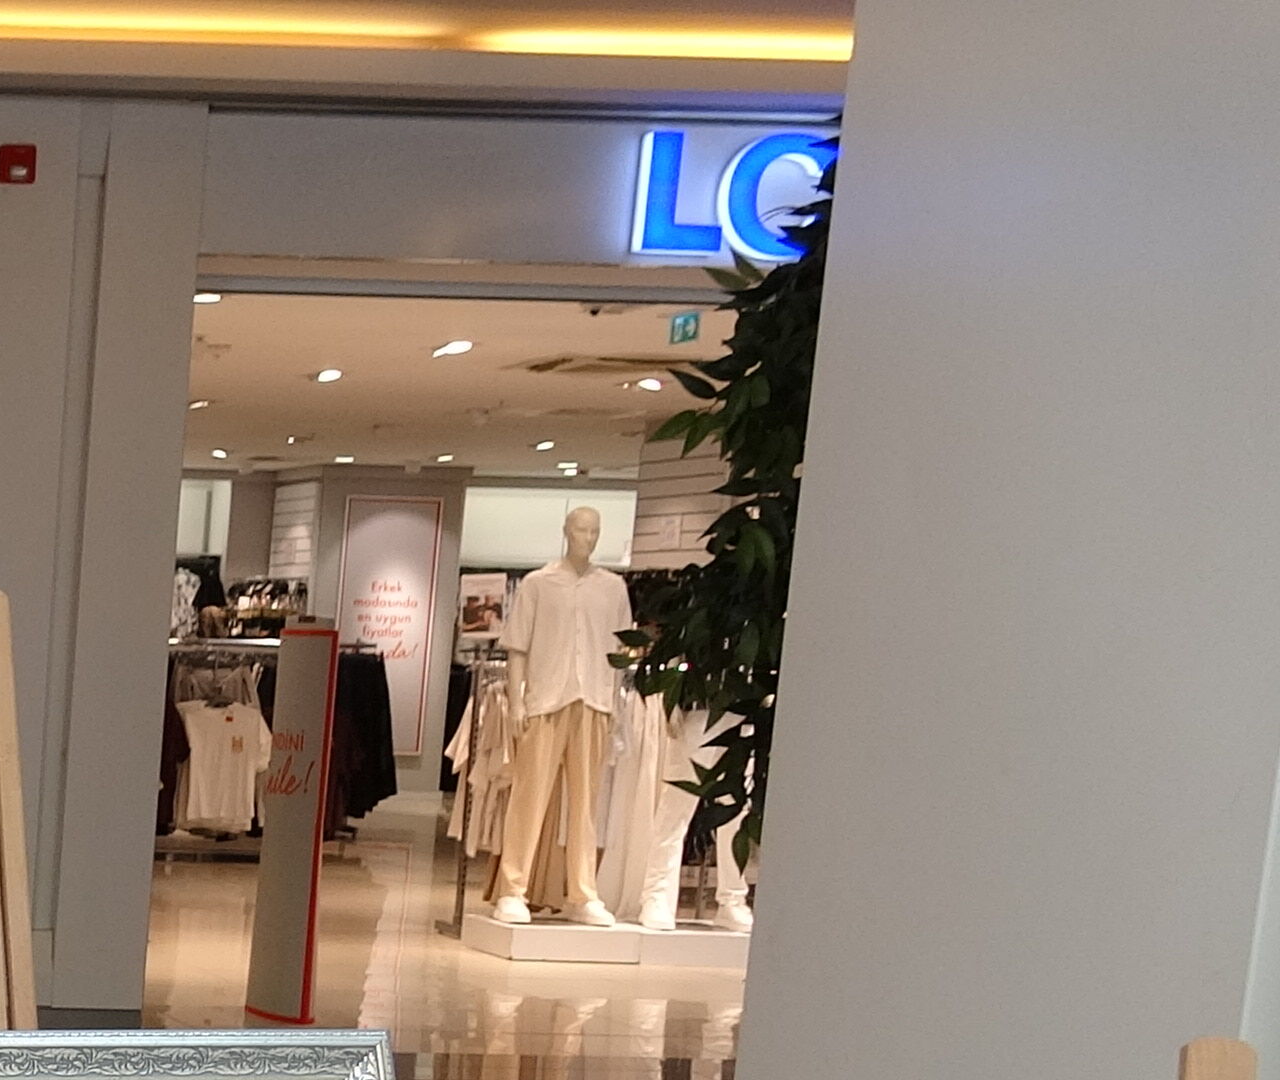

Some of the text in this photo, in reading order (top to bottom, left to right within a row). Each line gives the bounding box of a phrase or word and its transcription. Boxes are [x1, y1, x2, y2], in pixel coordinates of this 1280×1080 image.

[630, 129, 841, 262] LC
[371, 580, 403, 592] Erkek
[375, 614, 412, 625] uygun
